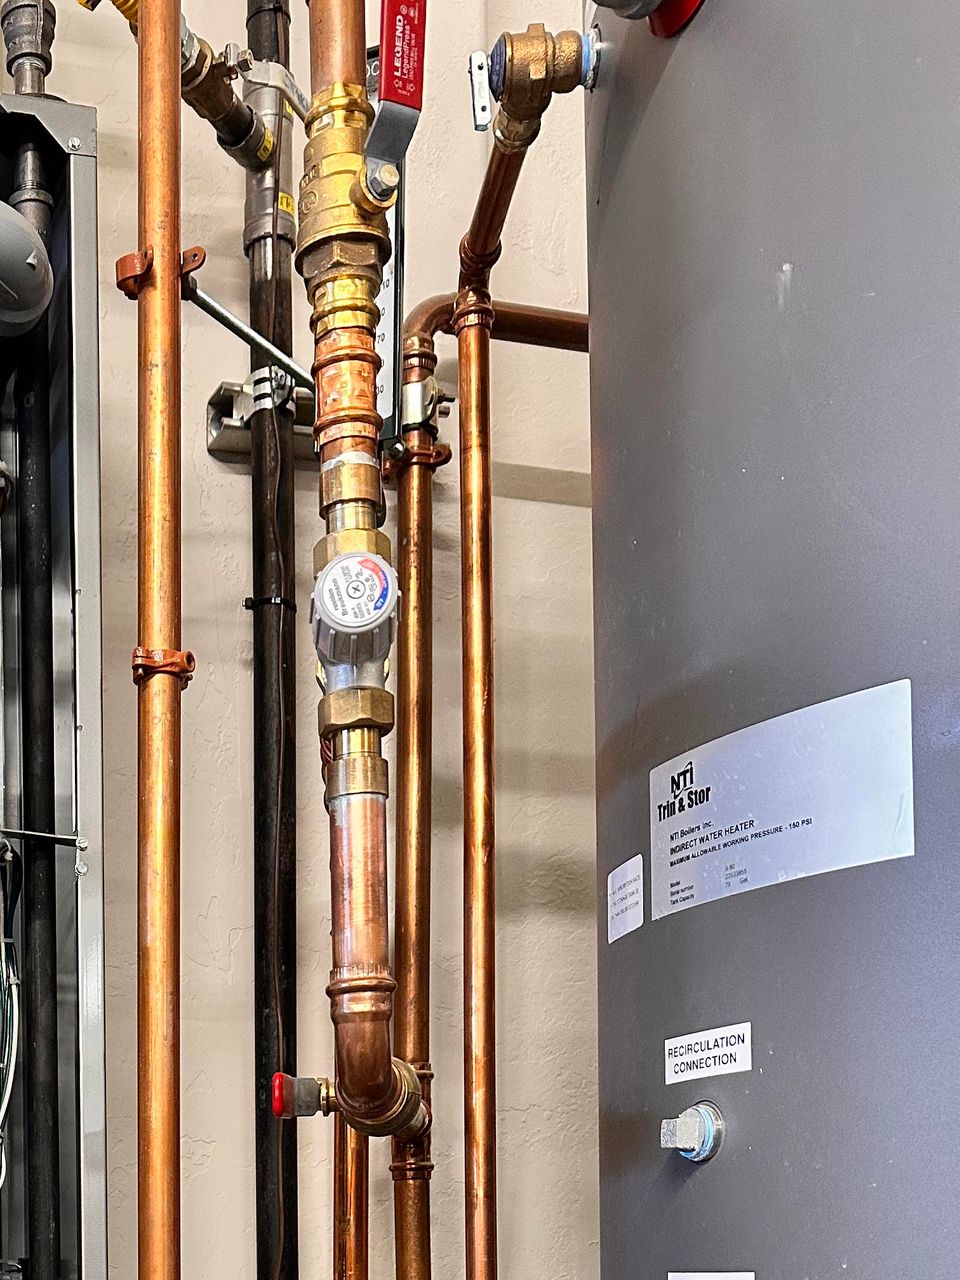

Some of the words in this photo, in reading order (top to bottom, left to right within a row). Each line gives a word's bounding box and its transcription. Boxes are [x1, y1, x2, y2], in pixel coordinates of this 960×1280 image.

[393, 14, 404, 77] LEGEND
[401, 25, 411, 79] LegendPress
[670, 764, 694, 797] NTI
[657, 800, 676, 822] Trin
[678, 797, 686, 813] &
[687, 786, 711, 809] Stor
[669, 830, 680, 842] NTI
[680, 824, 701, 837] Boilers
[669, 840, 698, 856] INDIRECT
[699, 830, 723, 845] WATER
[724, 819, 755, 837] HEATER
[669, 854, 691, 867] MAXIMUM
[691, 843, 722, 859] ALLOWABLE
[722, 835, 749, 850] WORKING
[750, 826, 784, 841] PRESSURE
[789, 821, 800, 830] 150
[801, 817, 813, 827] PSI
[667, 1033, 745, 1059] RECIRCULATION
[673, 1052, 737, 1075] CONNECTION
